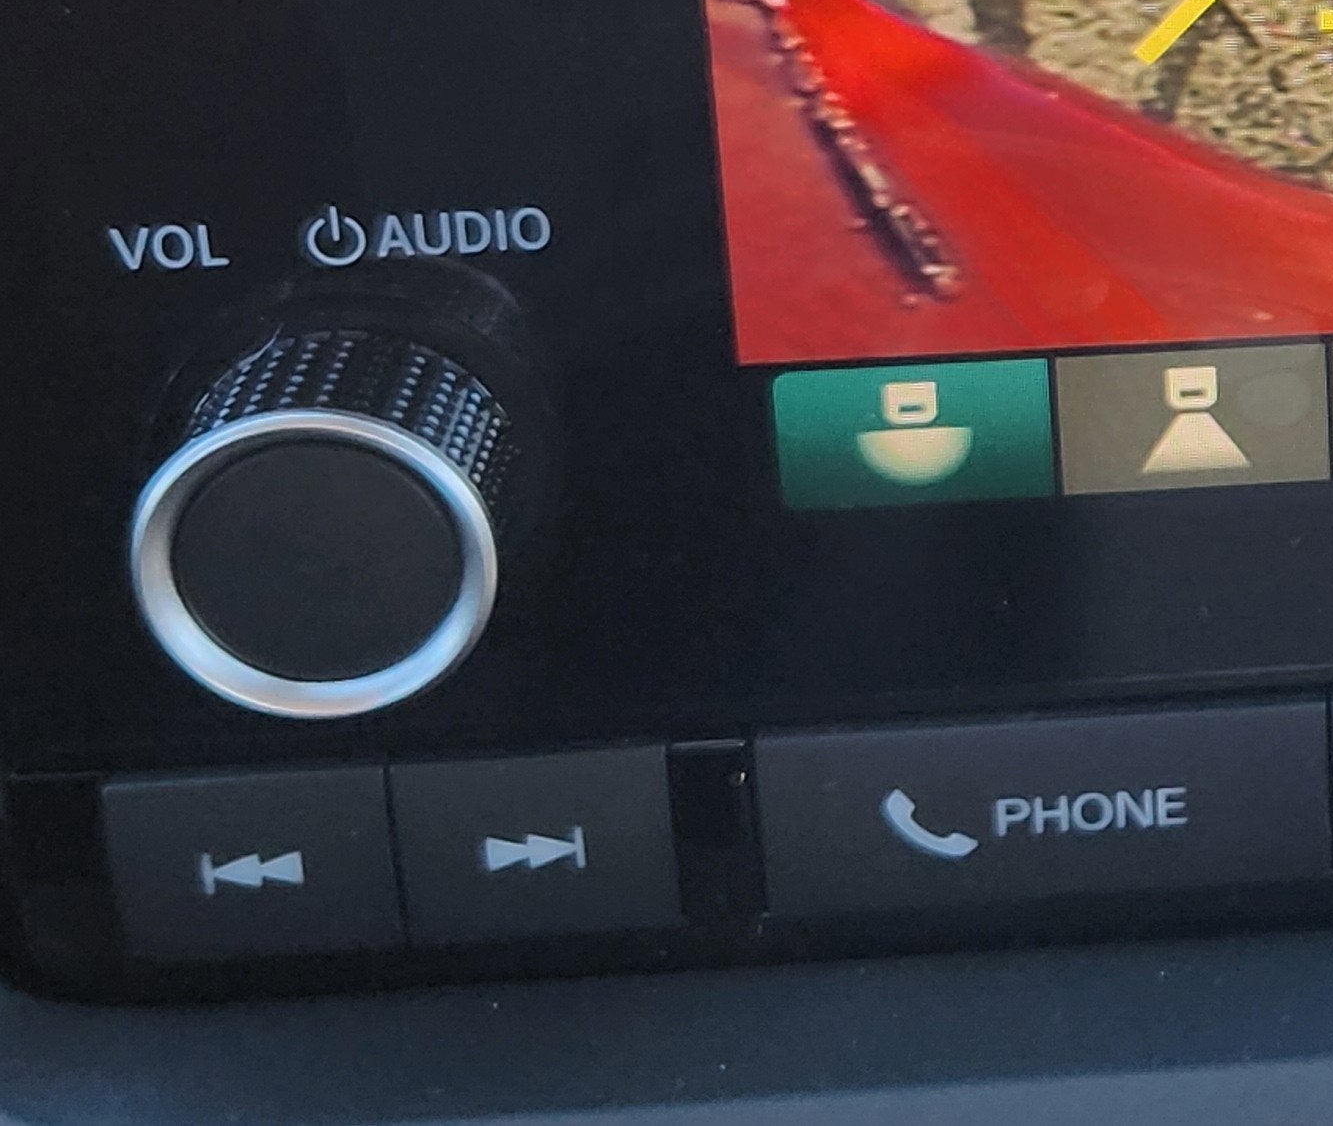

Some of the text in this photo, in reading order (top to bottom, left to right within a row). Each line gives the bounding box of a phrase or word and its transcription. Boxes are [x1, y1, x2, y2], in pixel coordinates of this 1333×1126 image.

[108, 224, 230, 271] VOL
[377, 207, 552, 259] AUDIO
[994, 786, 1187, 836] PHONE
